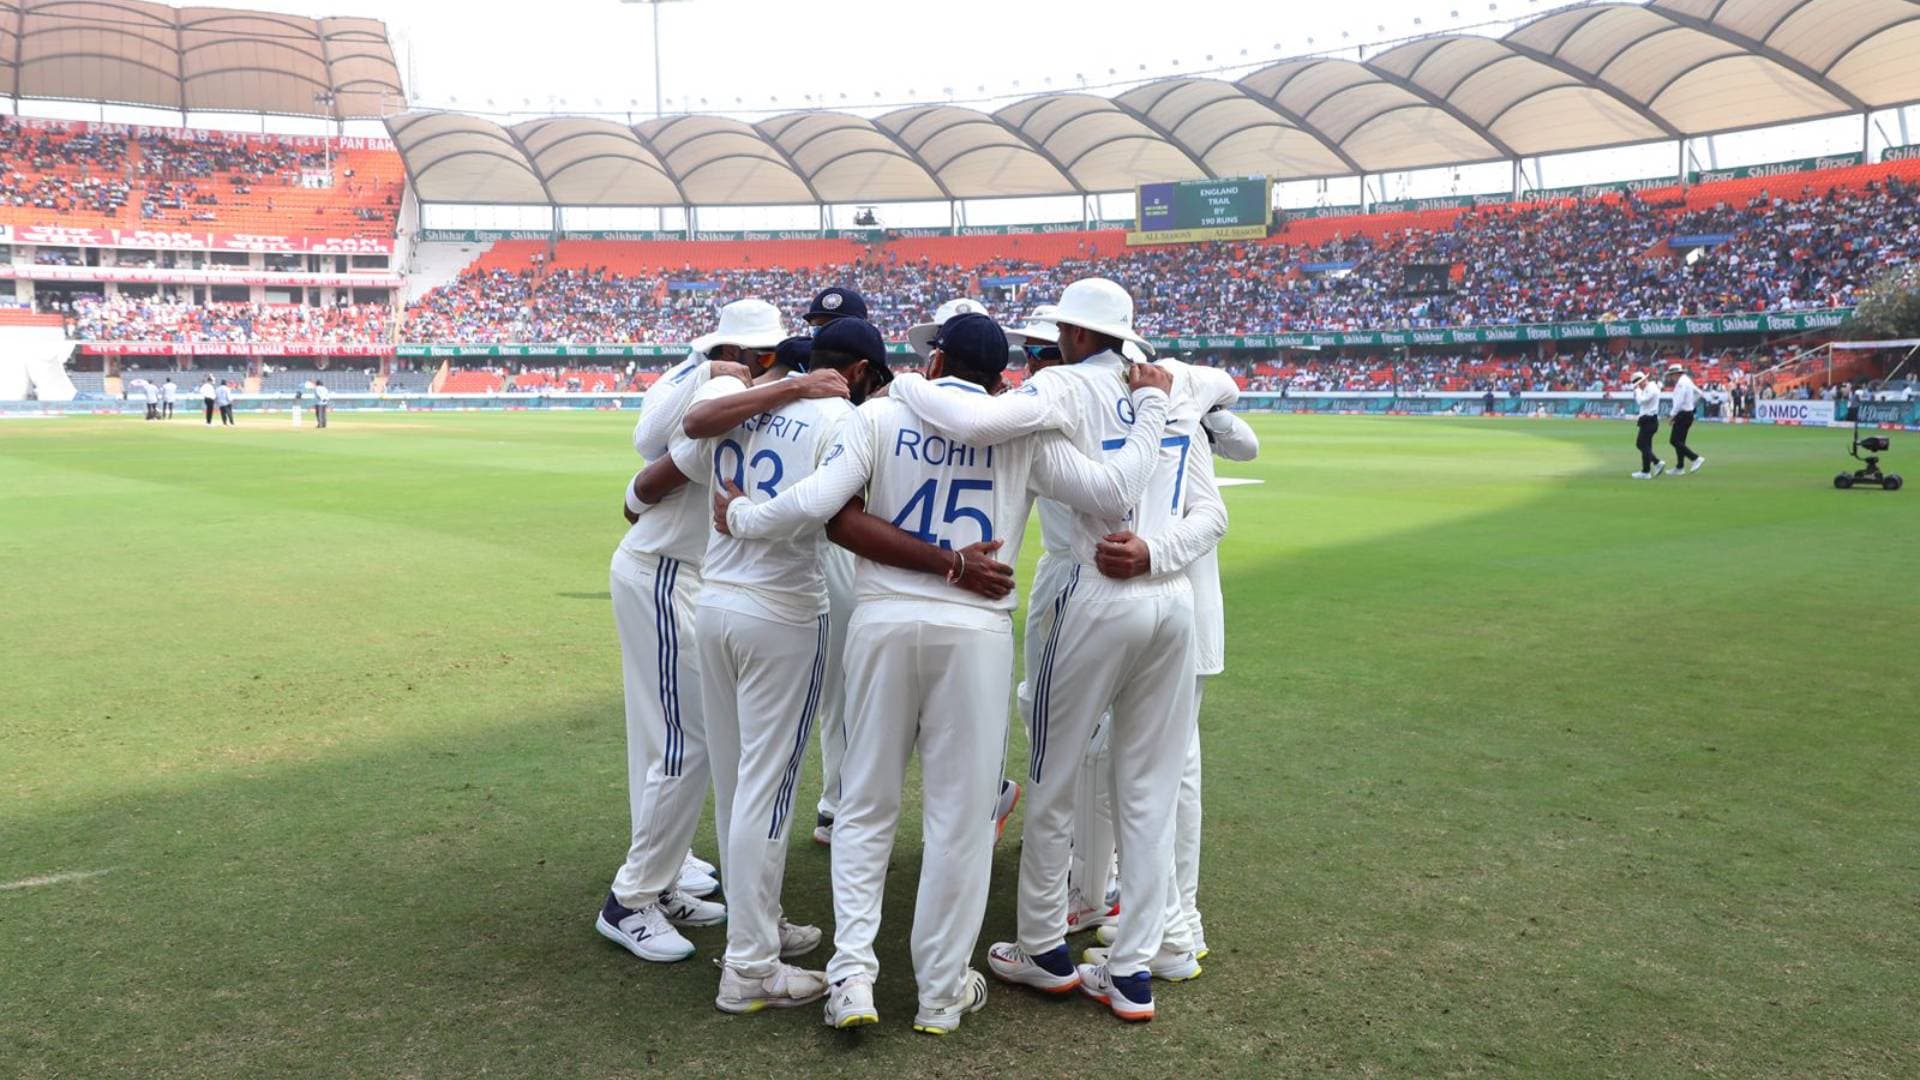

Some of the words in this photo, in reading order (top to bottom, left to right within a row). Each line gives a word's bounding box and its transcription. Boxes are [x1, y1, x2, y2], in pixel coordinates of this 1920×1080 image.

[340, 136, 364, 150] PAN
[1748, 164, 1804, 178] Shikhar
[1200, 186, 1238, 198] ENGLAND
[1626, 178, 1676, 192] Shikhar
[1208, 198, 1232, 206] TRAIL
[1214, 206, 1226, 214] BY
[1202, 216, 1216, 226] 190
[1216, 216, 1240, 226] RUNS
[426, 230, 466, 242] Shikhar
[602, 230, 644, 242] Shikhar
[696, 232, 736, 242] Shikhar
[778, 232, 818, 242] Shikhar
[960, 226, 998, 238] Shikhar
[1042, 224, 1080, 234] Shikhar
[1722, 318, 1760, 330] Shikhar
[1804, 314, 1844, 328] Shikhar
[1274, 336, 1304, 346] Shikhar
[1342, 334, 1374, 344] Shikhar
[1412, 330, 1444, 342] Shikhar
[1484, 328, 1518, 340] Shikhar
[1560, 326, 1596, 338] Shikhar
[1640, 322, 1678, 334] Shikhar
[172, 342, 192, 354] PAN
[196, 342, 226, 354] BAHAR
[230, 342, 250, 354] PAN
[252, 344, 284, 356] BAHAR
[1208, 338, 1236, 348] Shikhar
[396, 346, 426, 356] Shikhar
[460, 346, 490, 356] Shikhar
[528, 346, 558, 356] Shikhar
[596, 346, 626, 356] Shikhar
[660, 346, 690, 356] Shikhar
[1768, 404, 1808, 418] NMDC
[890, 478, 994, 550] 45
